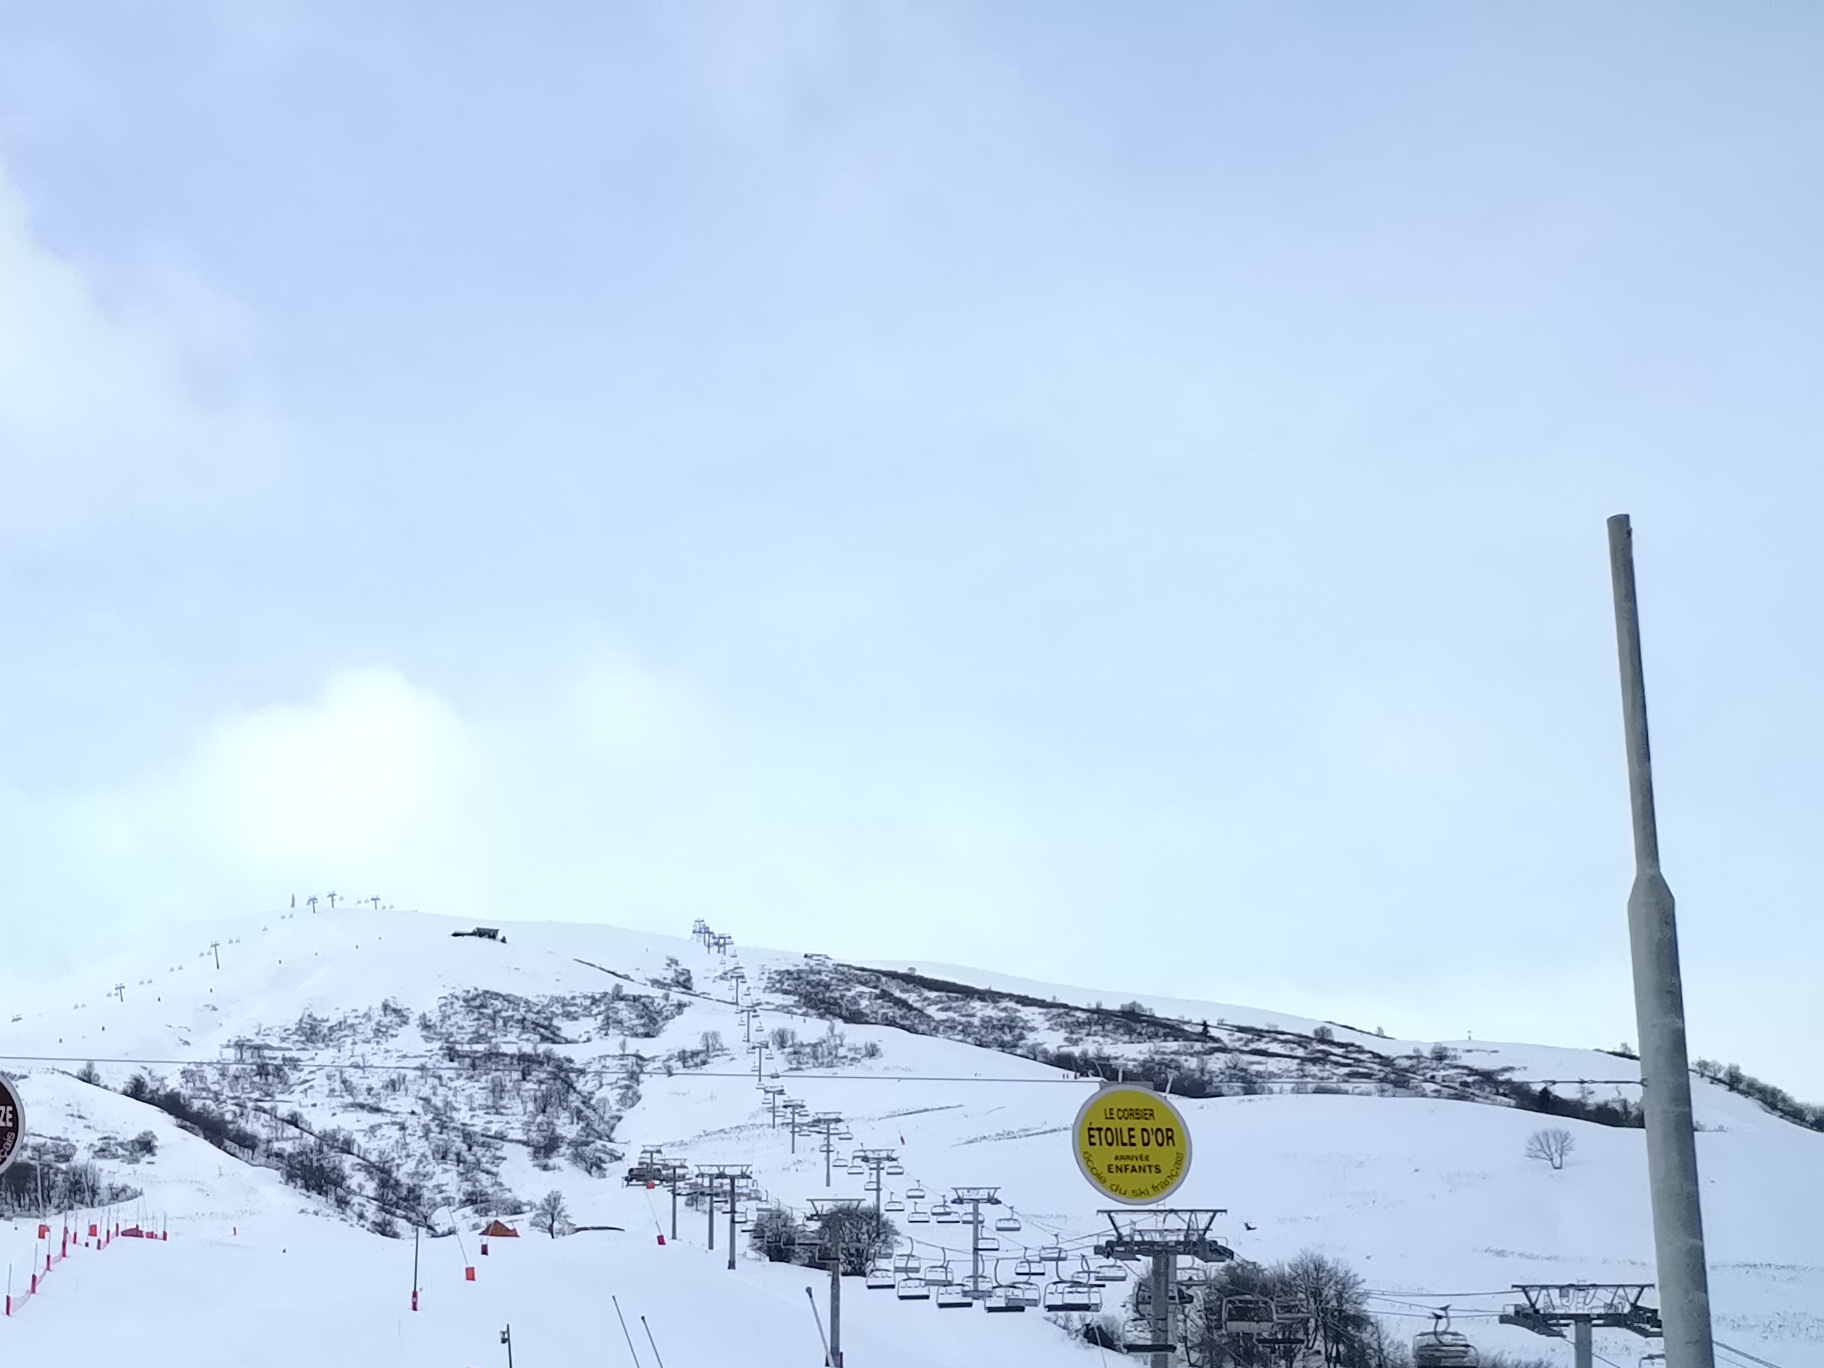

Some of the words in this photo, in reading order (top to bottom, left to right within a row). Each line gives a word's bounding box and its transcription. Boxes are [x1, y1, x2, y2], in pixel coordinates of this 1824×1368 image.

[1104, 1107, 1115, 1120] LE
[1116, 1108, 1155, 1121] CORBIER
[1087, 1122, 1137, 1147] ÉTOILE
[1141, 1127, 1176, 1147] D'OR
[1114, 1153, 1150, 1162] ARRIVÉE
[1107, 1163, 1162, 1174] ENFANTS
[1109, 1183, 1128, 1196] du
[1131, 1188, 1151, 1197] ski
